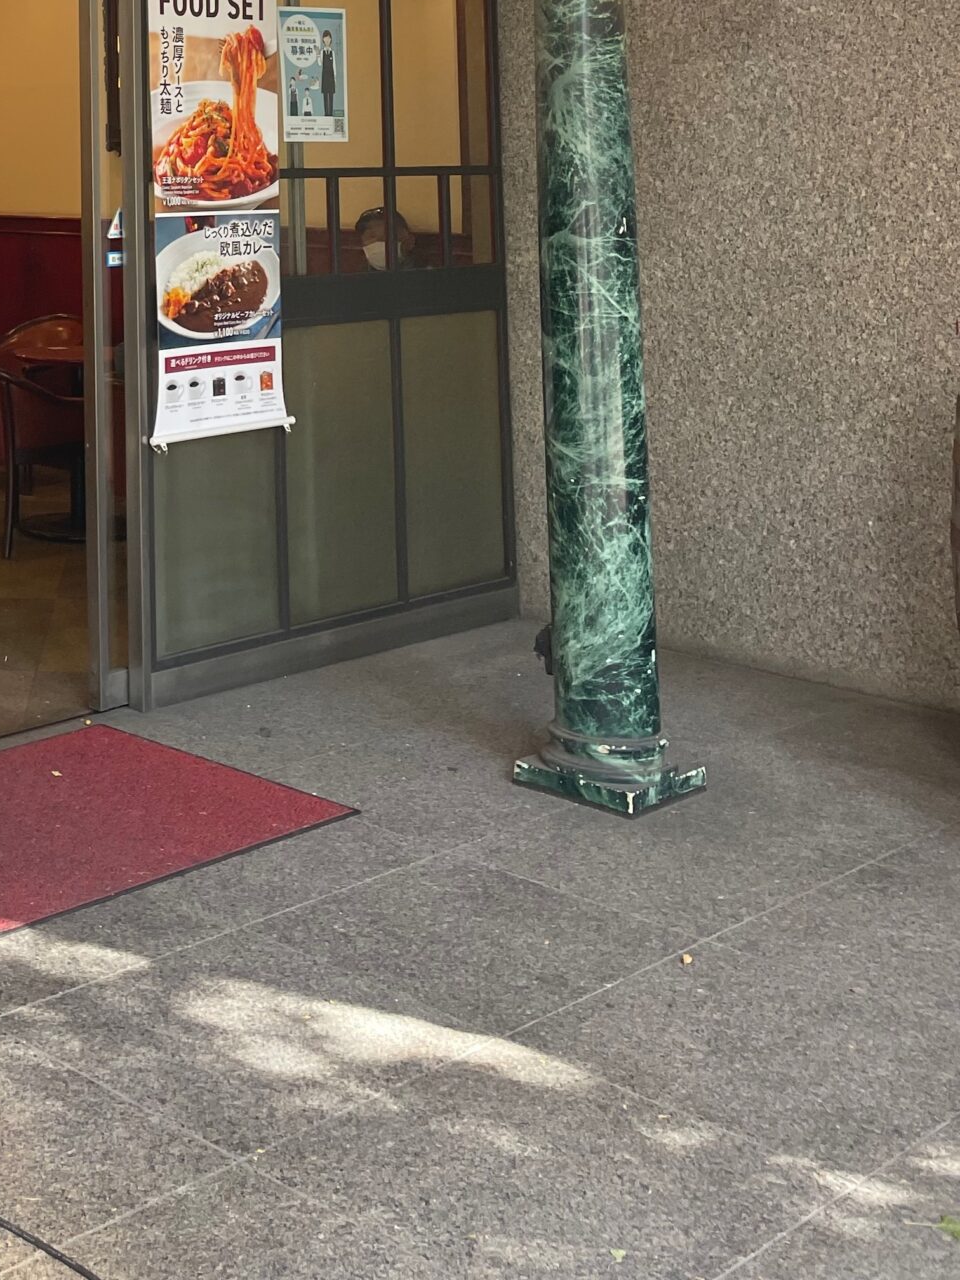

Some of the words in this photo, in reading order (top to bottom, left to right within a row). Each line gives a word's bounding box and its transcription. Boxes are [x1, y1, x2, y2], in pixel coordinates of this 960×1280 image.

[159, 26, 172, 115] もっちり太麺
[172, 26, 185, 114] 濃厚ソースと
[203, 221, 274, 240] じっくり煮込んだ
[219, 240, 273, 257] 欧風カレー
